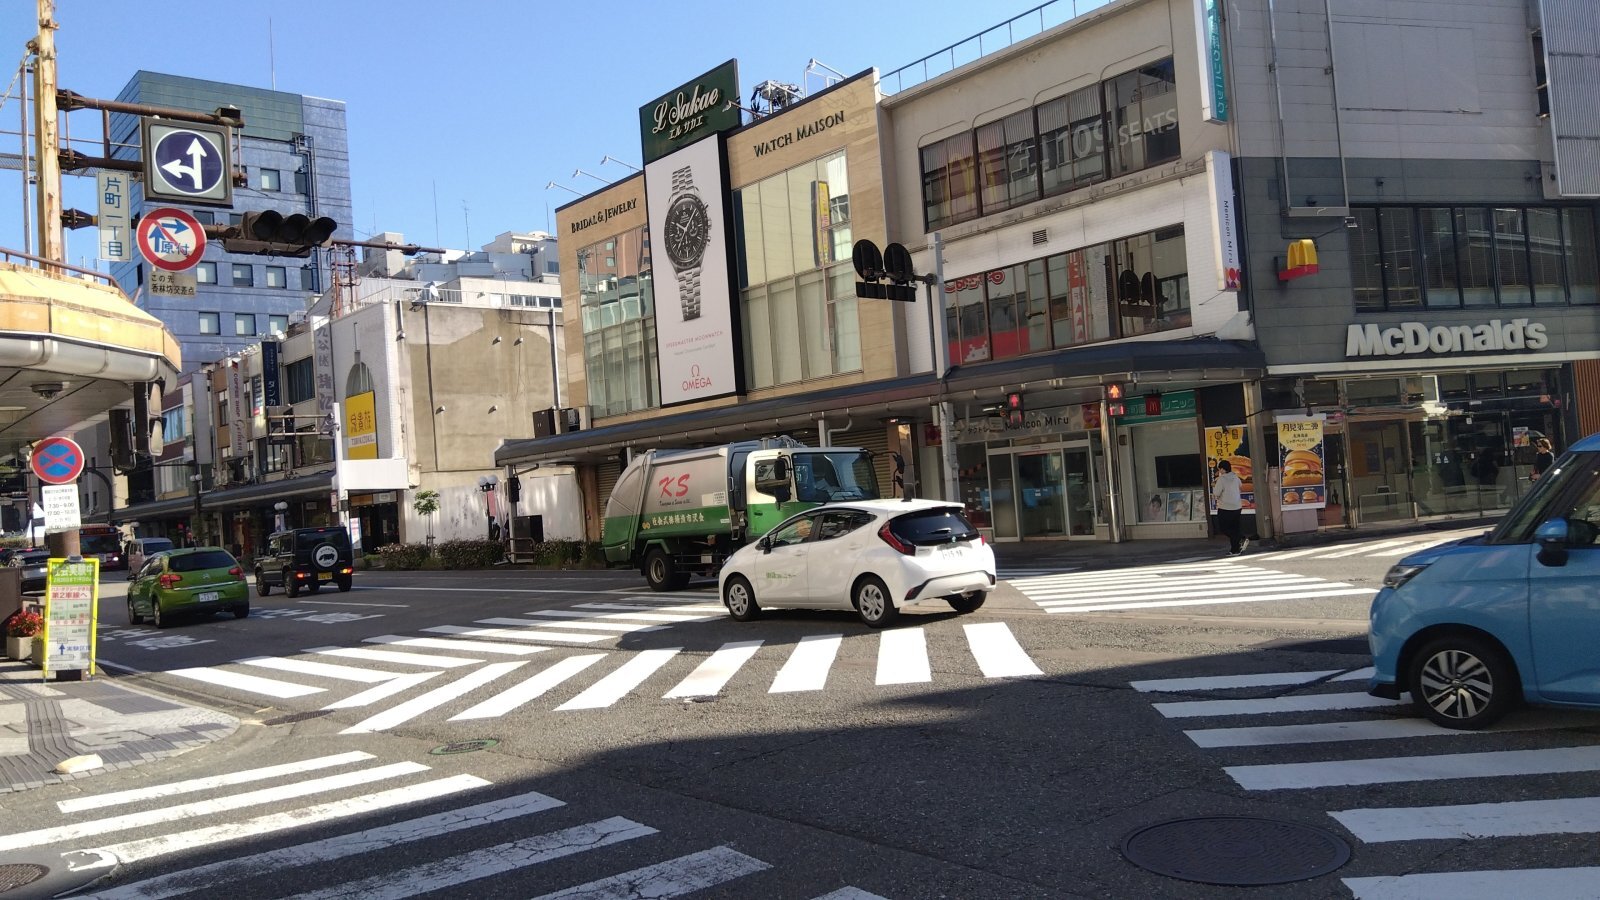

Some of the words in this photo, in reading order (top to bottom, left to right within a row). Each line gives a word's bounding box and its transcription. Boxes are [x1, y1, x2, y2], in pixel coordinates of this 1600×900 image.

[668, 84, 719, 125] Sakae
[753, 132, 793, 158] WATCH
[796, 110, 845, 142] MAISON
[1118, 107, 1178, 147] SEATS
[104, 176, 123, 257] 片町一丁目
[1223, 200, 1232, 237] Menicon
[161, 240, 189, 256] 原付
[151, 274, 175, 283] この先
[151, 284, 195, 296] 香林坊交差点
[1346, 318, 1549, 357] McDonald's
[682, 377, 712, 391] OMEGA
[1045, 416, 1069, 427] Miru
[1282, 422, 1319, 432] 月見第二弾
[659, 473, 690, 498] KS
